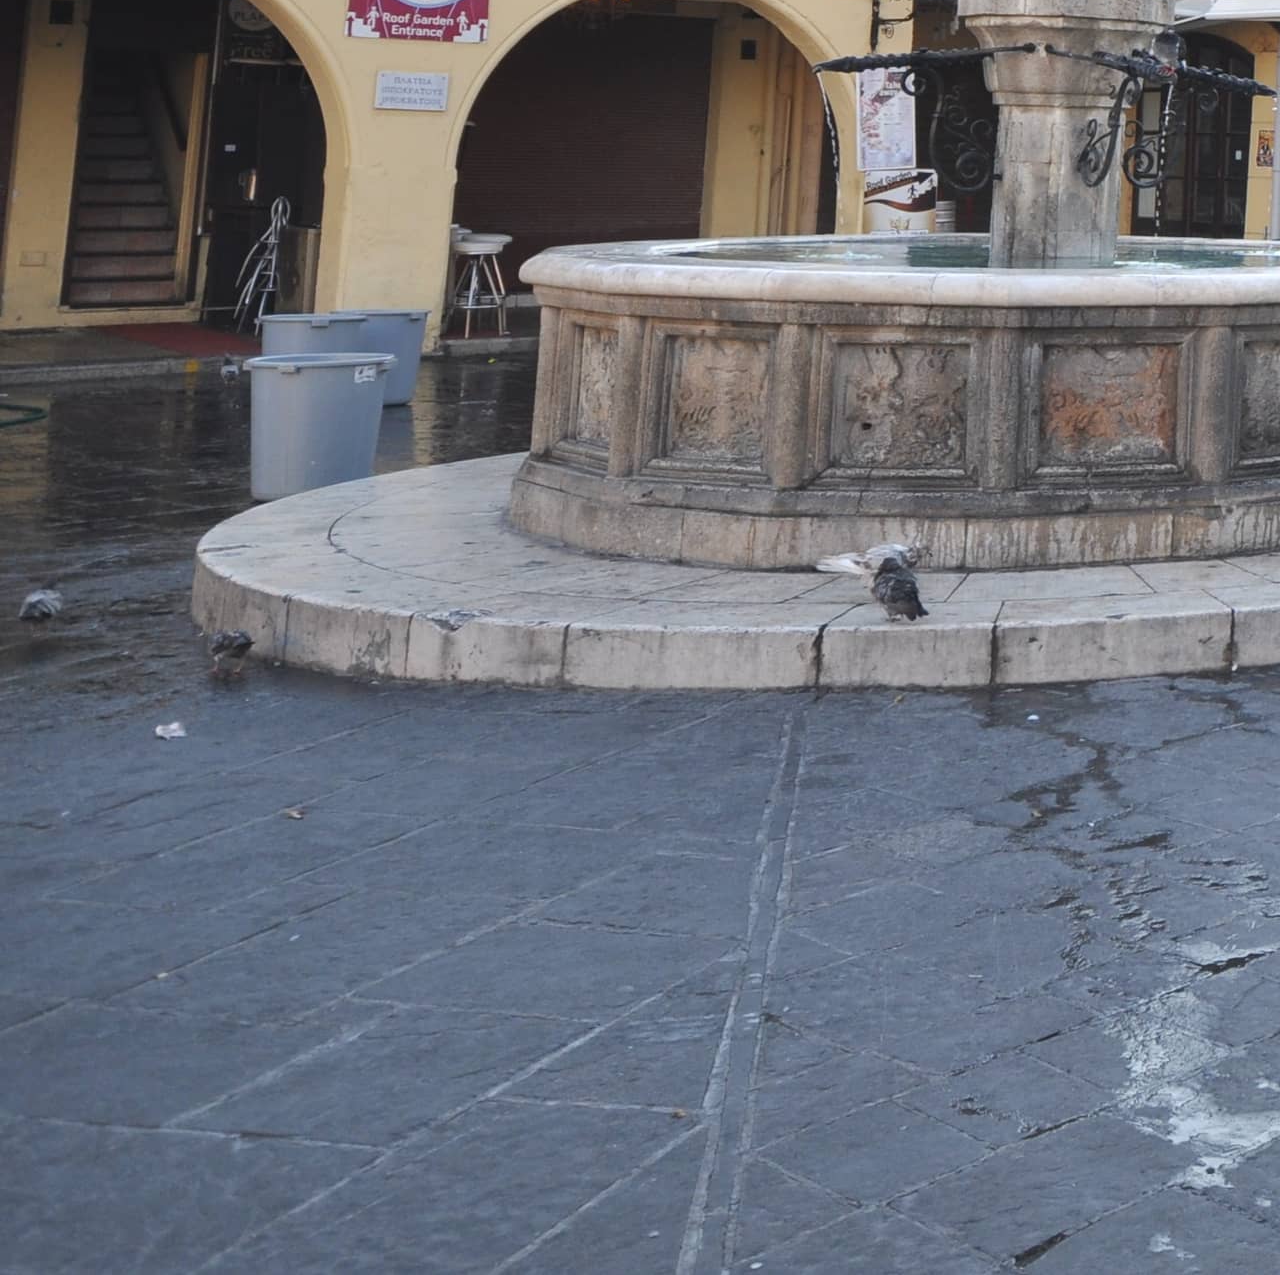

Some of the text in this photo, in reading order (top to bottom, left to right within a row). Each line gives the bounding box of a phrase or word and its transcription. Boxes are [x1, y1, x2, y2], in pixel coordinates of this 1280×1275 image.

[382, 12, 454, 27] Roof Garden
[391, 25, 445, 37] Entrance
